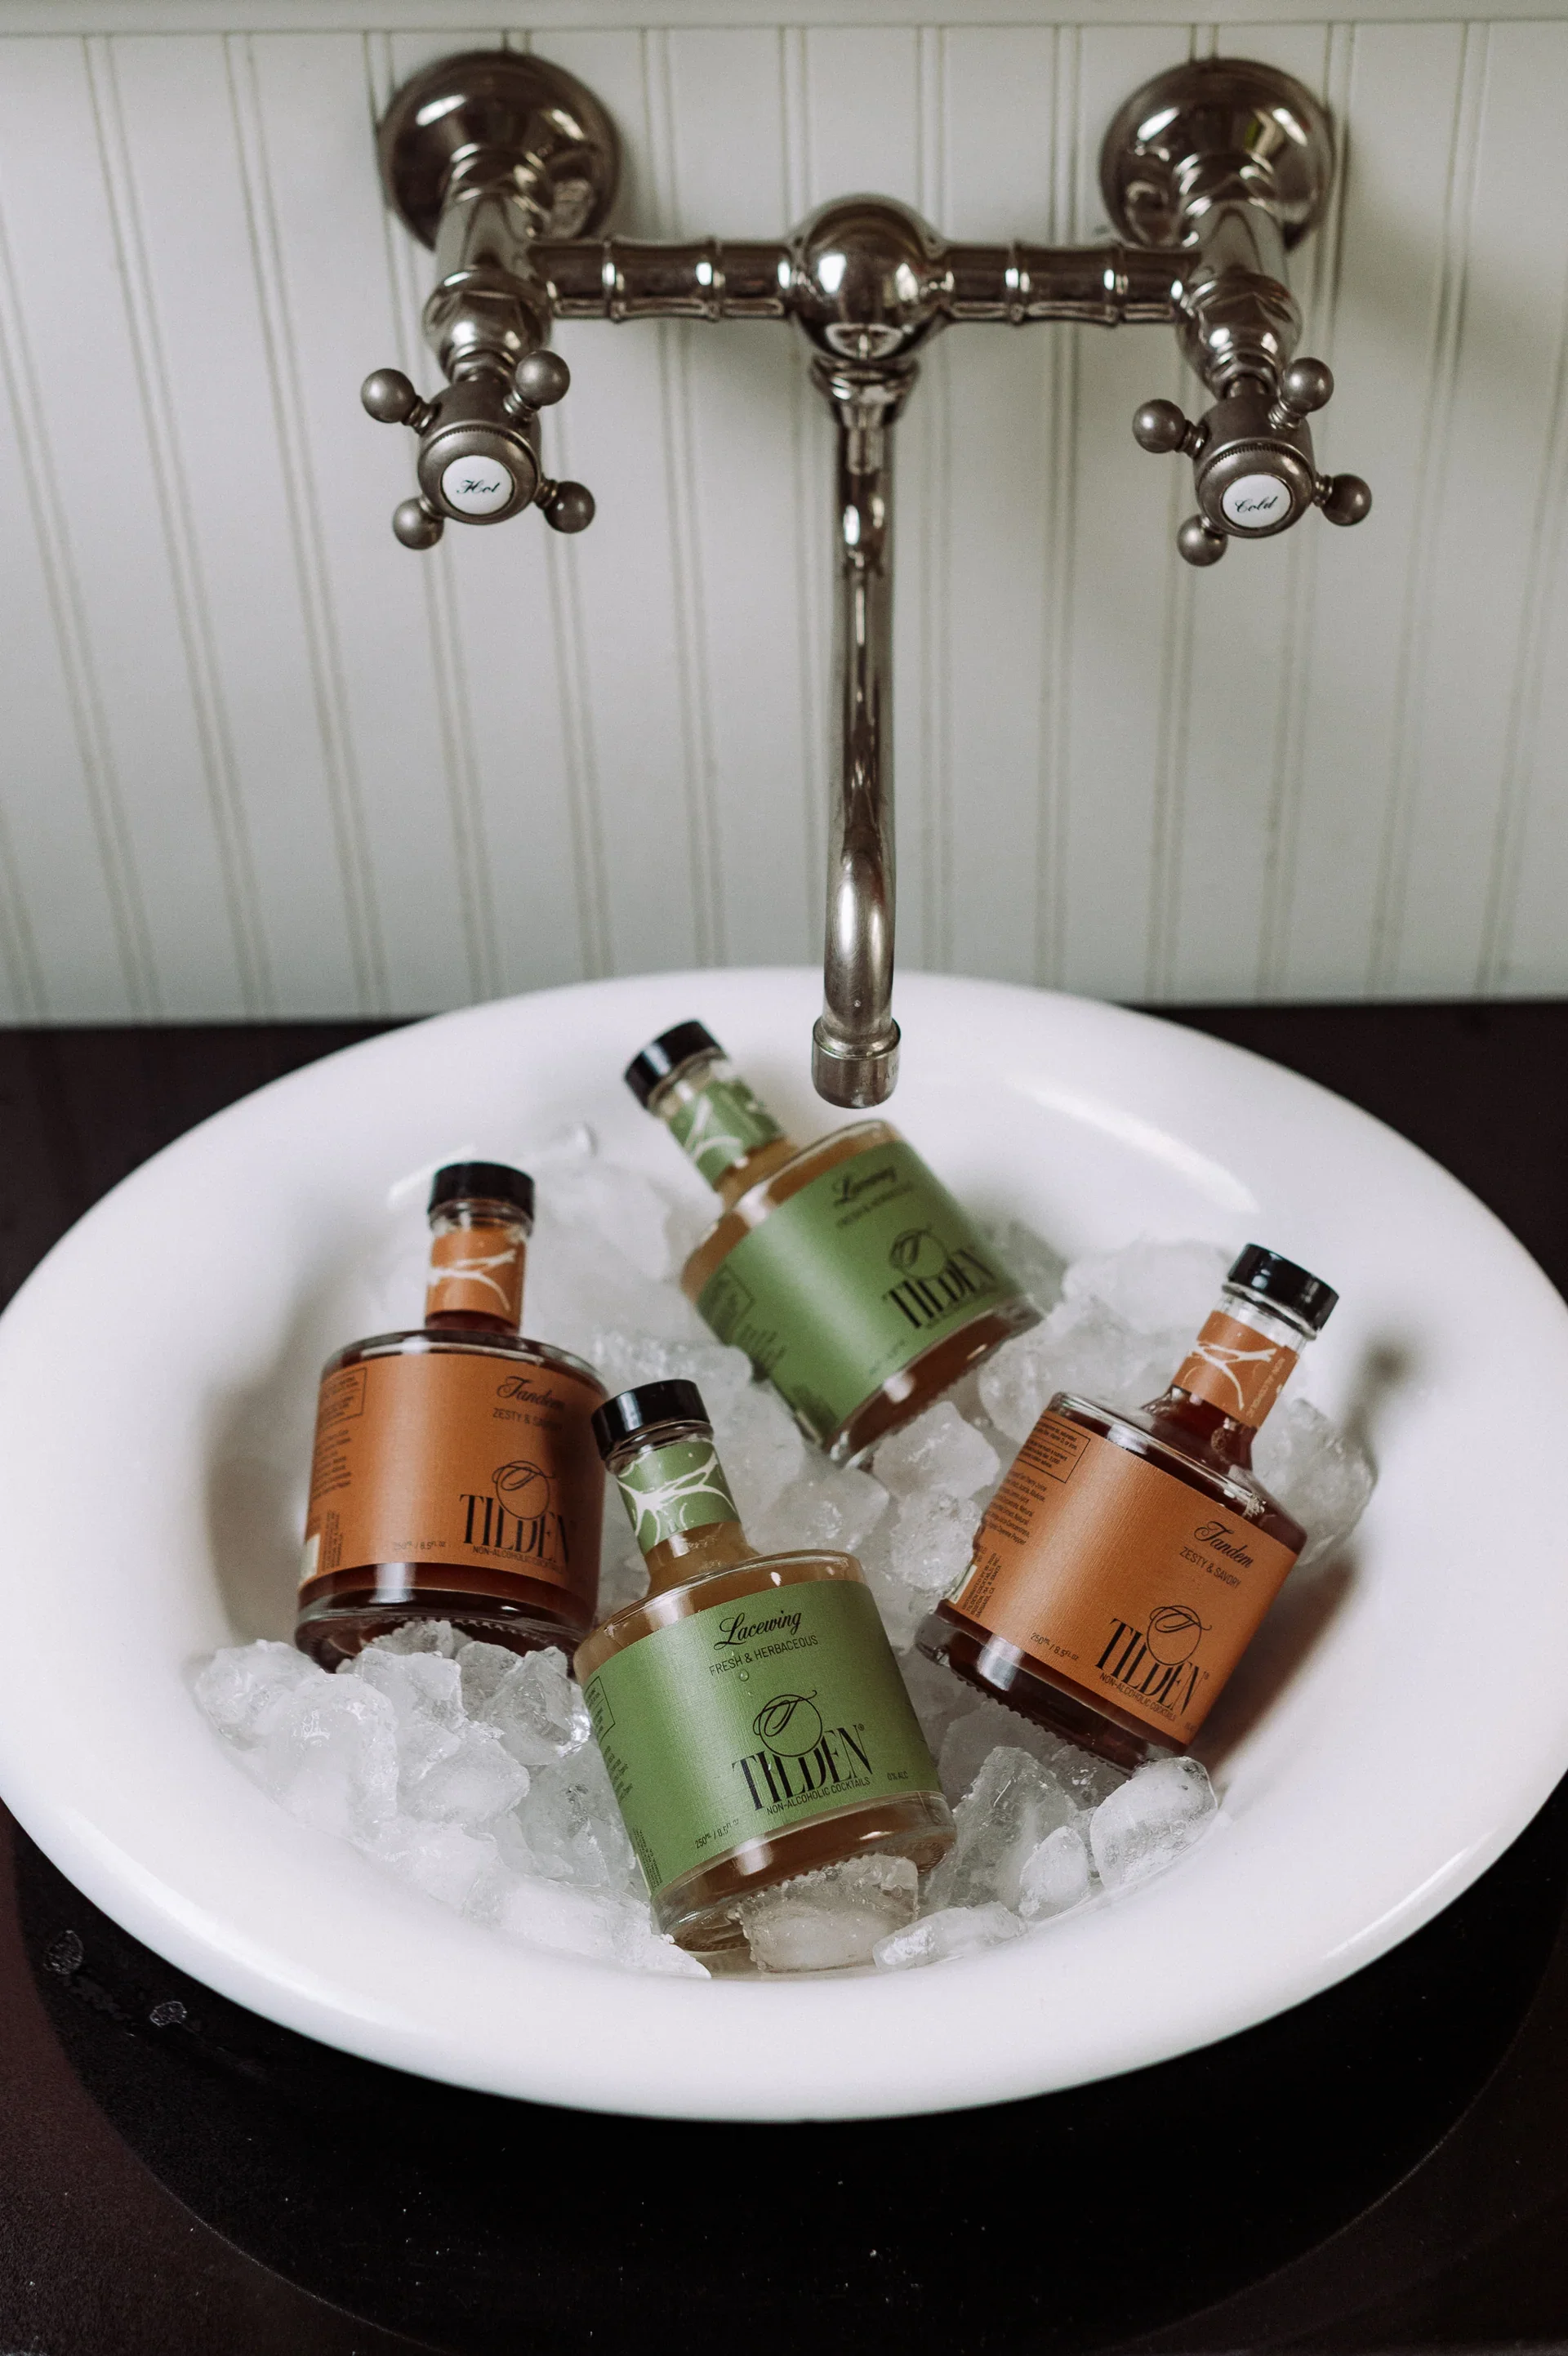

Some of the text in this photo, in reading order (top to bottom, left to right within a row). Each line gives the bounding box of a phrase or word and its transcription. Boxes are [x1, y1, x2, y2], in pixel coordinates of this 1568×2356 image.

[457, 479, 501, 493] Hot
[1235, 496, 1278, 513] Cold
[493, 1408, 521, 1422] ZESTY
[1194, 1521, 1254, 1568] Tandem
[1179, 1546, 1241, 1588] ZESTY & SAVORY
[714, 1610, 802, 1650] Lacewing
[709, 1635, 818, 1676] FRESH & HERBACEOUS
[1099, 1672, 1152, 1708] NON-ALCOHOLIC
[767, 1776, 871, 1815] NON-ALCOHOLIC COCKTAILS
